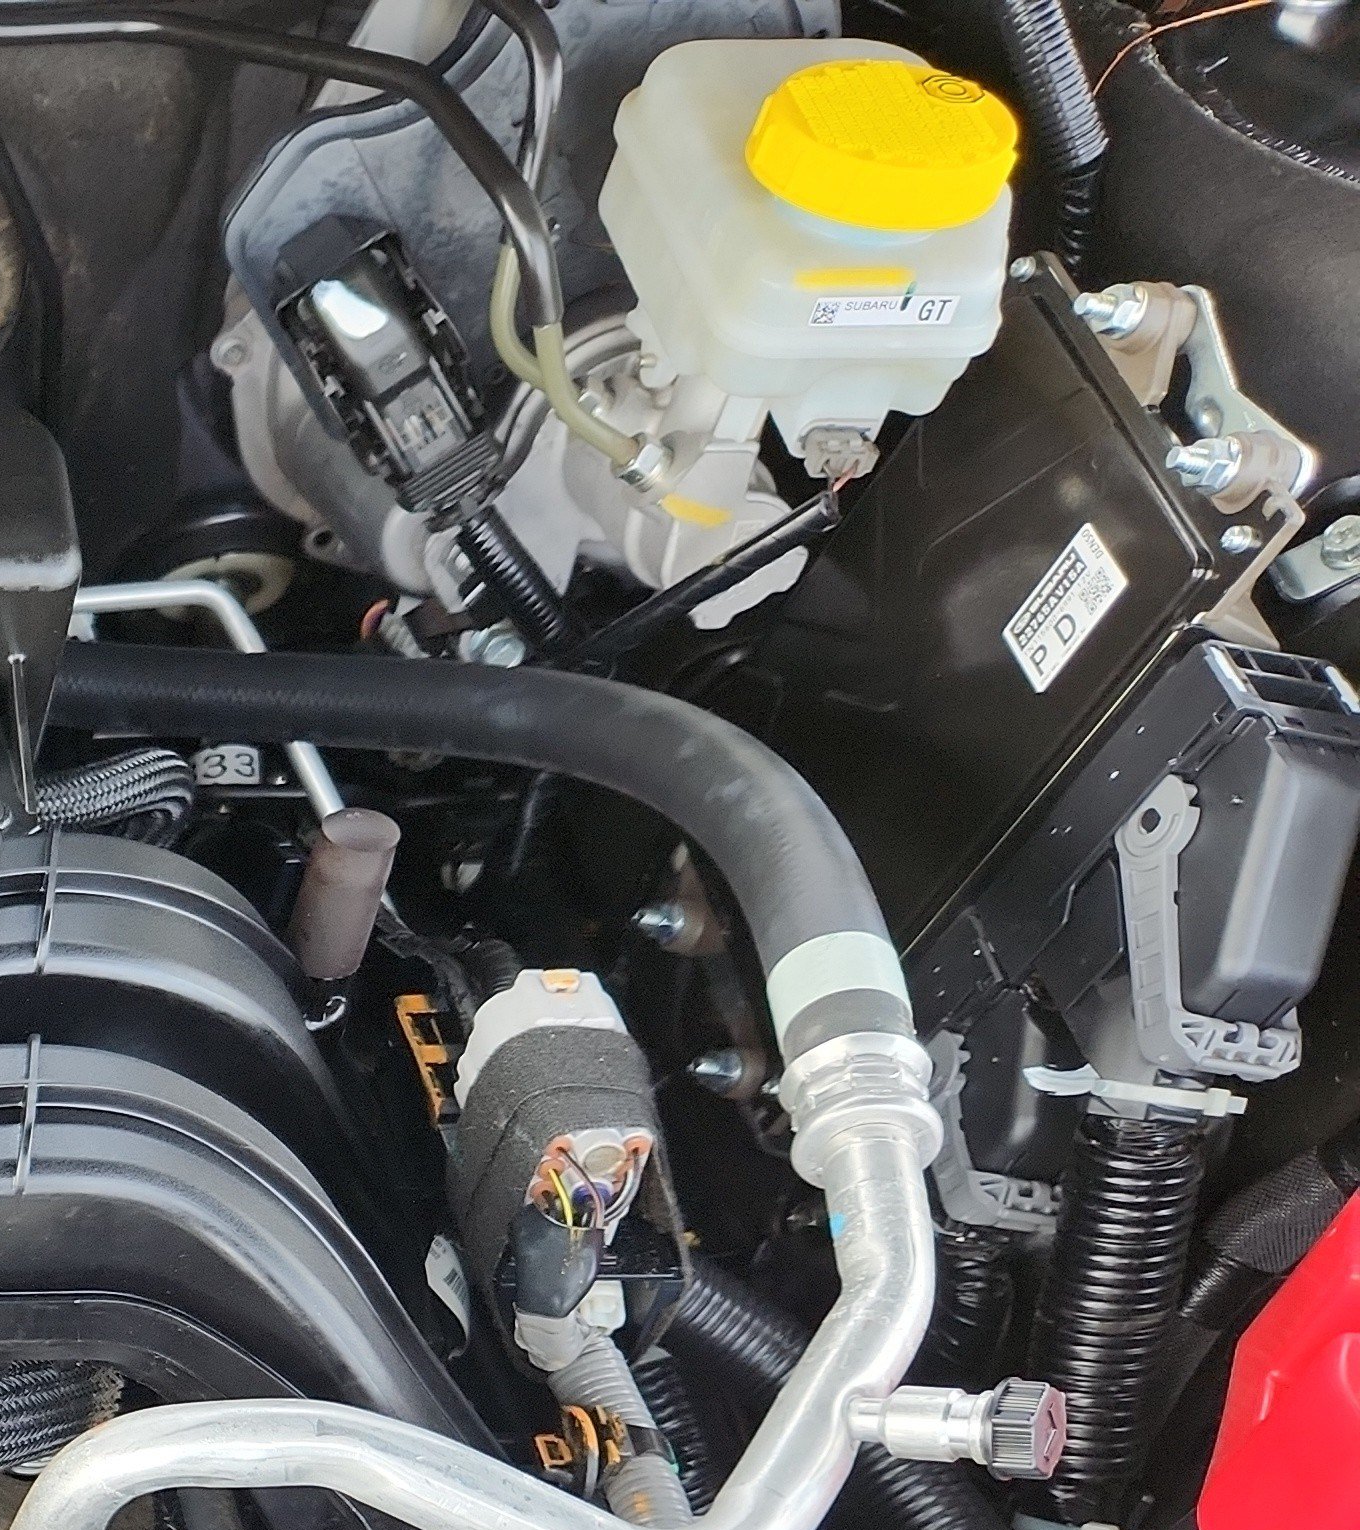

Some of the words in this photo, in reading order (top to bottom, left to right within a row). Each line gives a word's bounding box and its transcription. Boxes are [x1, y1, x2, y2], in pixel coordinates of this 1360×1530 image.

[844, 300, 897, 311] SUBARU
[918, 299, 952, 321] GT
[1081, 528, 1105, 559] DENSO
[1029, 643, 1048, 677] P
[1053, 613, 1077, 646] D
